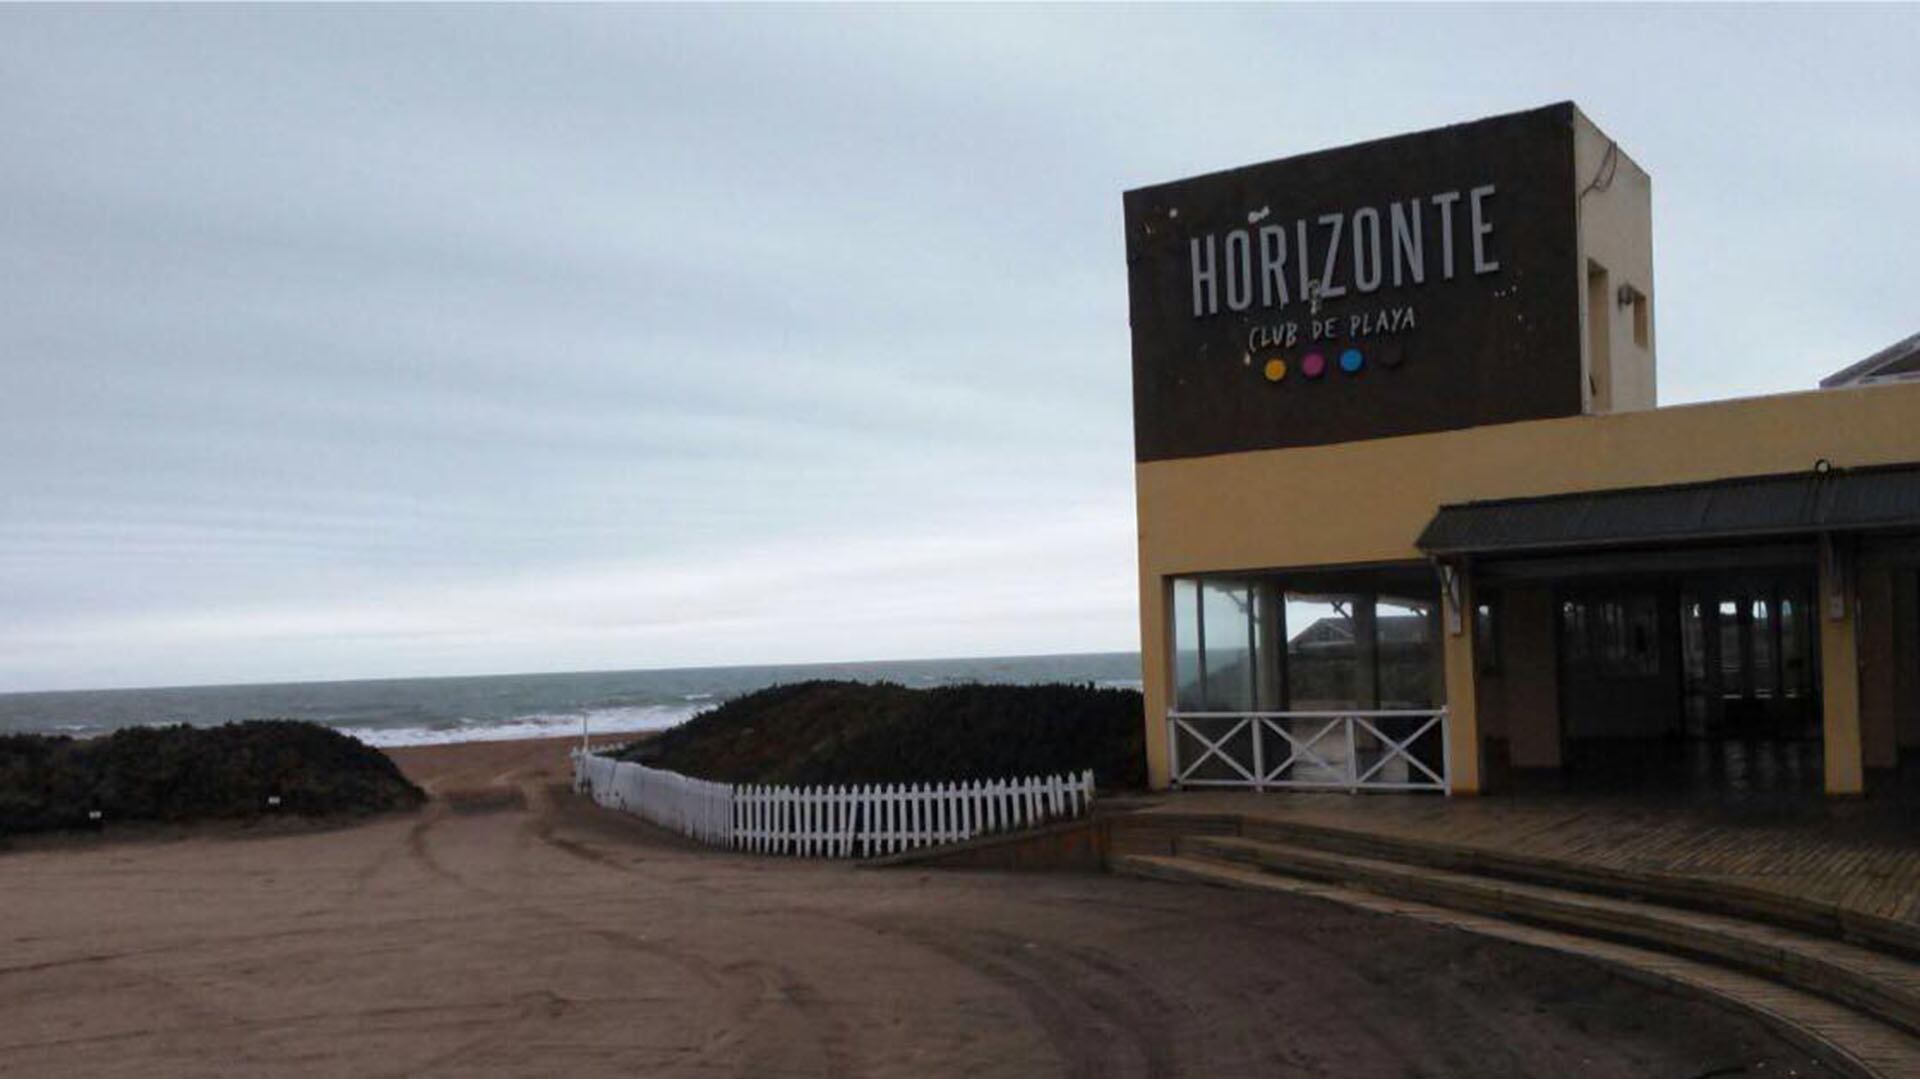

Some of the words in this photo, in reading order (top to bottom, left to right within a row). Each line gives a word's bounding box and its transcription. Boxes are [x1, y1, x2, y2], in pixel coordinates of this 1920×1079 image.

[1191, 185, 1499, 317] HORIZONTE
[1249, 321, 1297, 352] CLUB
[1312, 317, 1338, 340] DE
[1350, 306, 1416, 337] PLAYA
